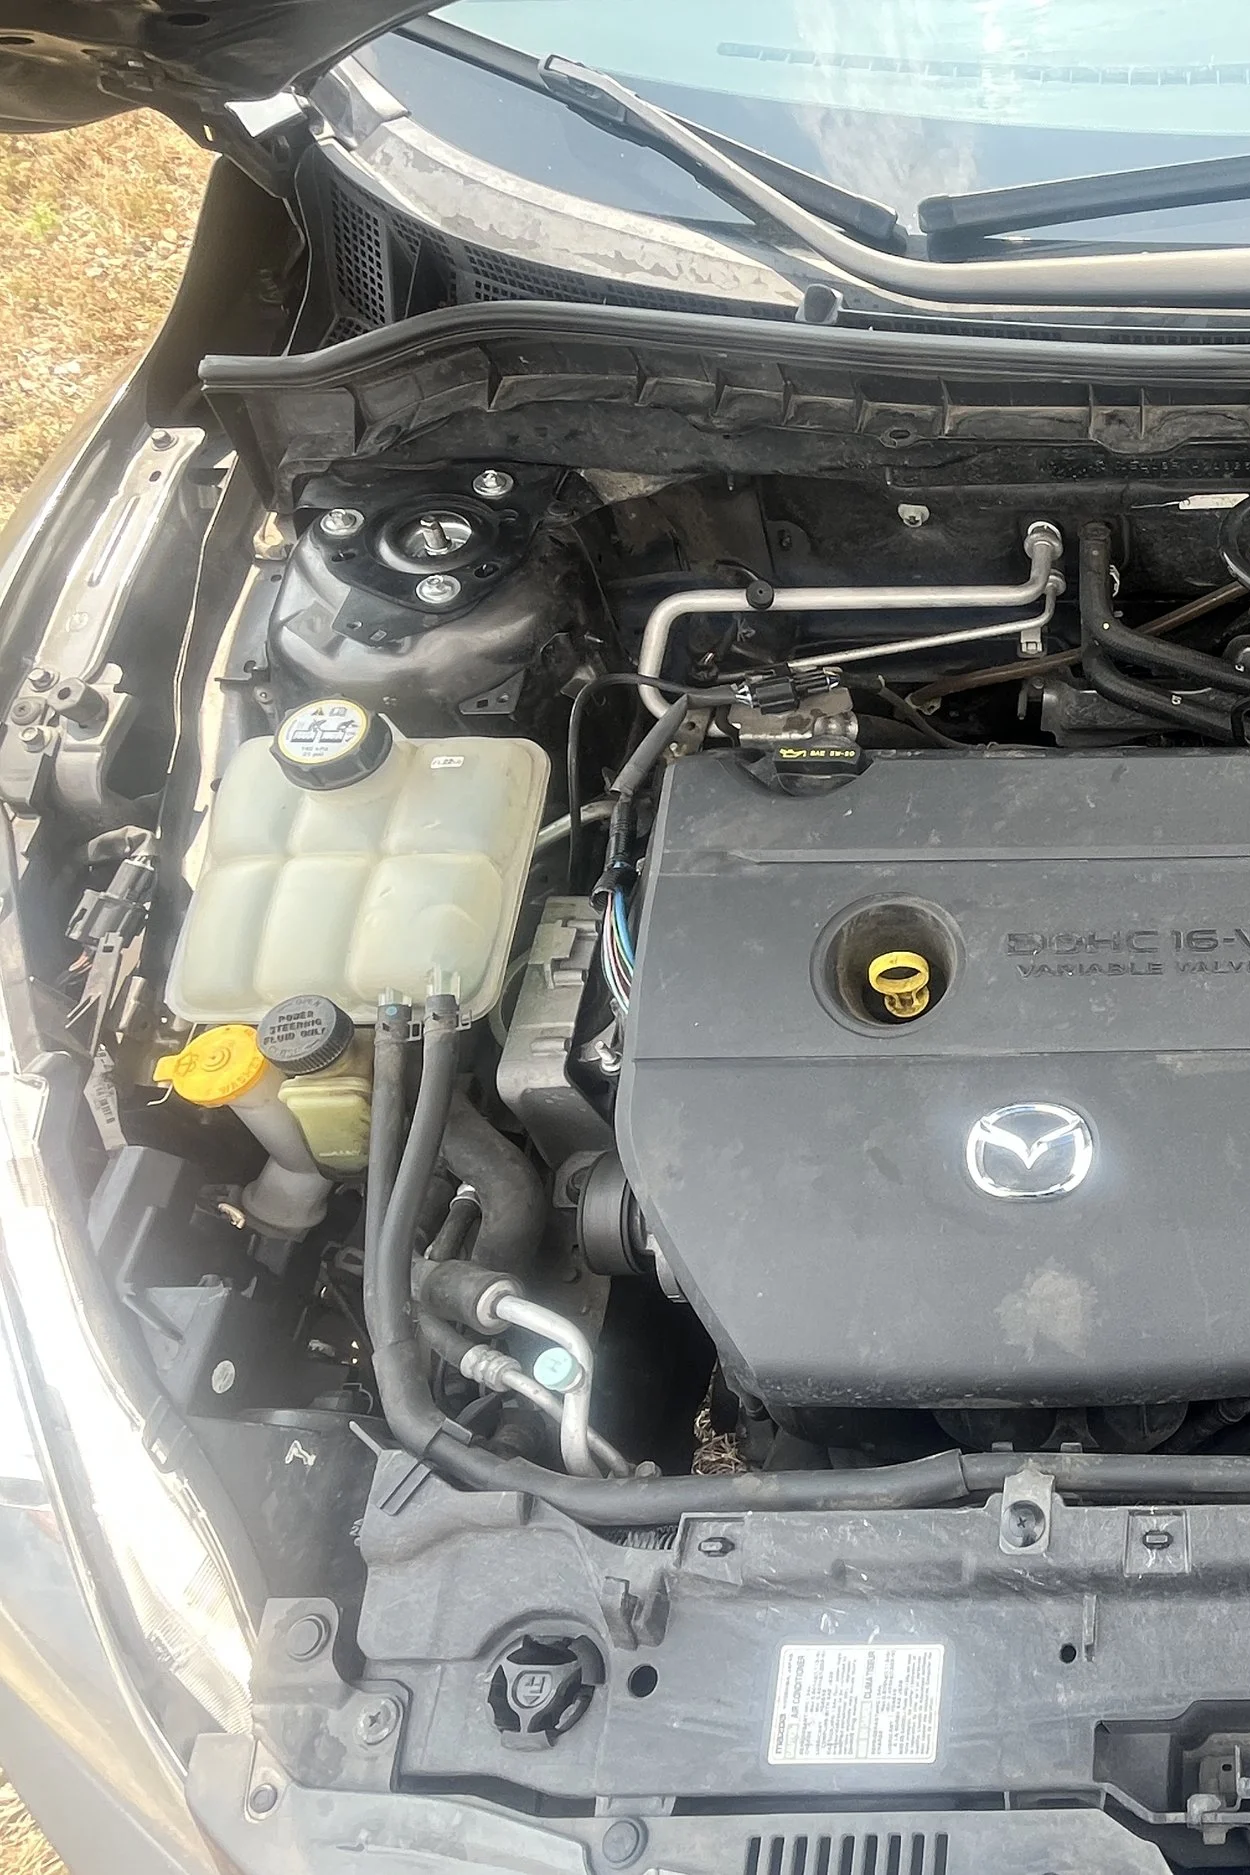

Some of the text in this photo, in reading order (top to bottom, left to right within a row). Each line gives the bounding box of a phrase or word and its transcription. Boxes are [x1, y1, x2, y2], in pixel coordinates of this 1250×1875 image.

[1006, 929, 1160, 956] DOHC
[1015, 961, 1163, 979] VARIABLE
[278, 1010, 314, 1023] POWER
[269, 1018, 322, 1035] STEERING
[263, 1027, 326, 1045] FLUID ONLY
[790, 1655, 806, 1719] AIR CONDITIONER
[775, 1713, 787, 1755] mazda
